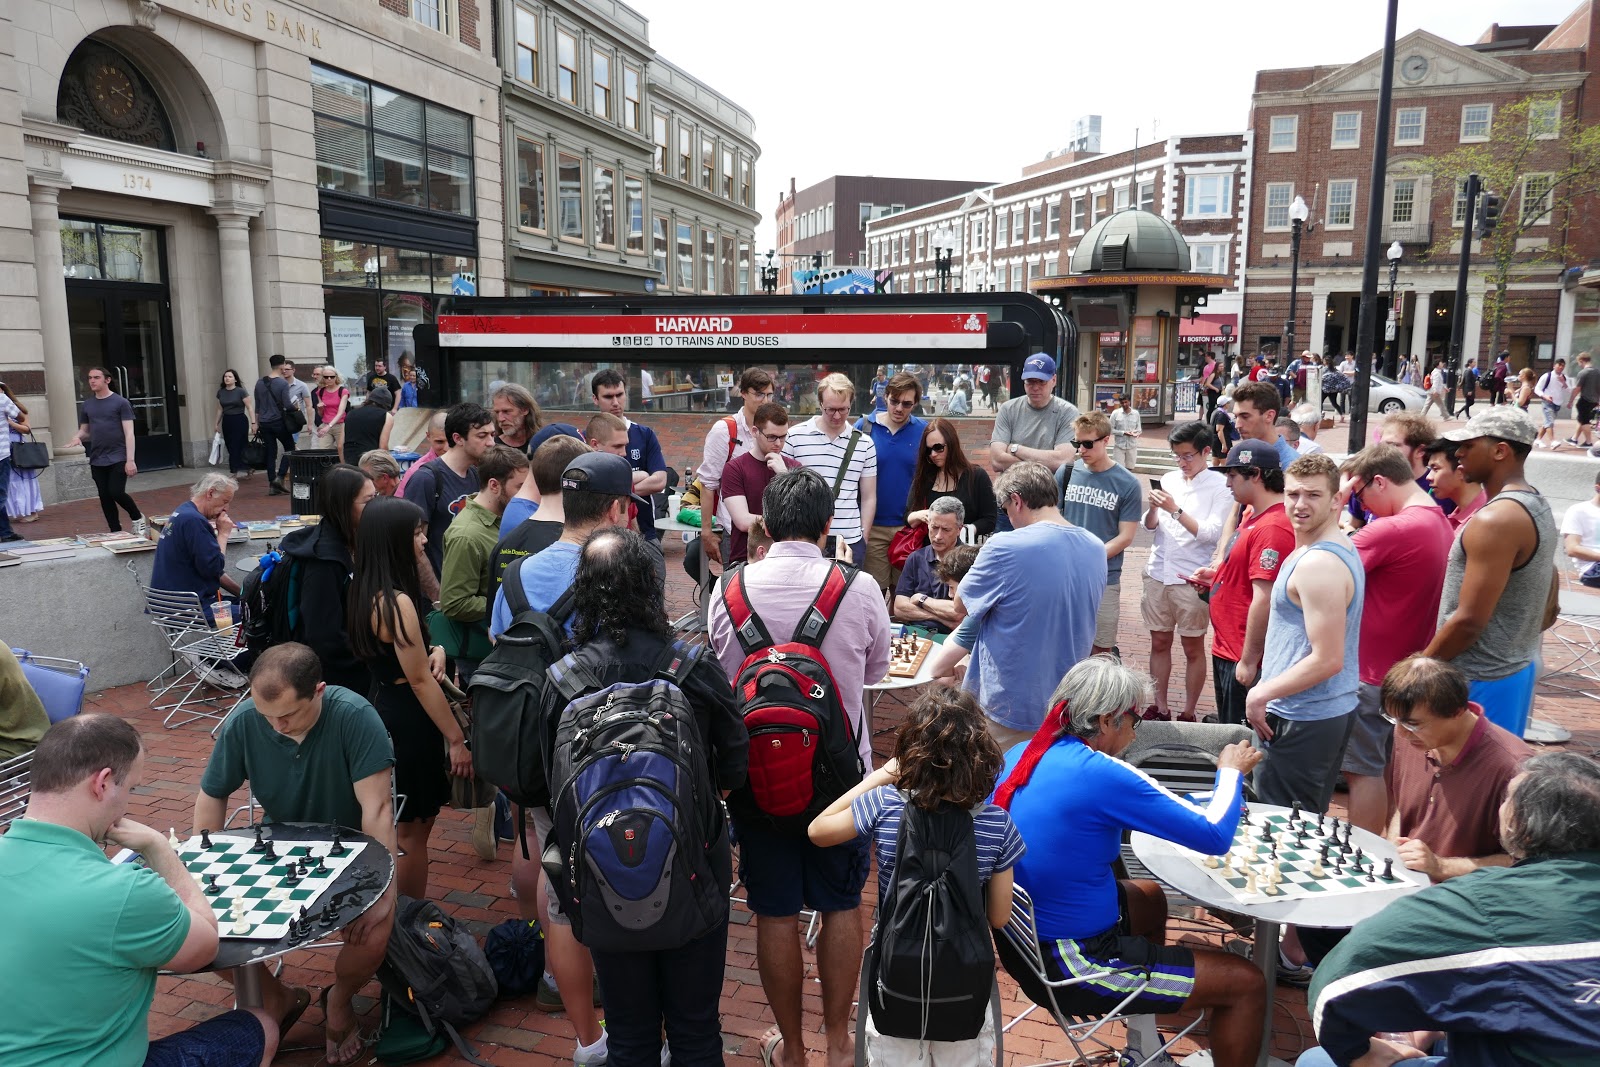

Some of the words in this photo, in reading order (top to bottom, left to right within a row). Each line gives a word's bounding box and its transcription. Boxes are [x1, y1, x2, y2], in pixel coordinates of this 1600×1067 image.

[265, 10, 321, 48] BANK
[122, 172, 152, 191] 1374
[1087, 275, 1129, 284] CAMBRIDGE
[1131, 275, 1164, 283] VISITOR'S
[1165, 275, 1207, 284] INFORMATION
[655, 317, 733, 333] HARVARD
[659, 336, 673, 346] TO
[676, 336, 714, 346] TRAINS
[716, 336, 740, 346] AND
[742, 336, 779, 346] BUSES
[1065, 493, 1116, 511] BOULDERS
[1066, 484, 1119, 503] BROOKLYN
